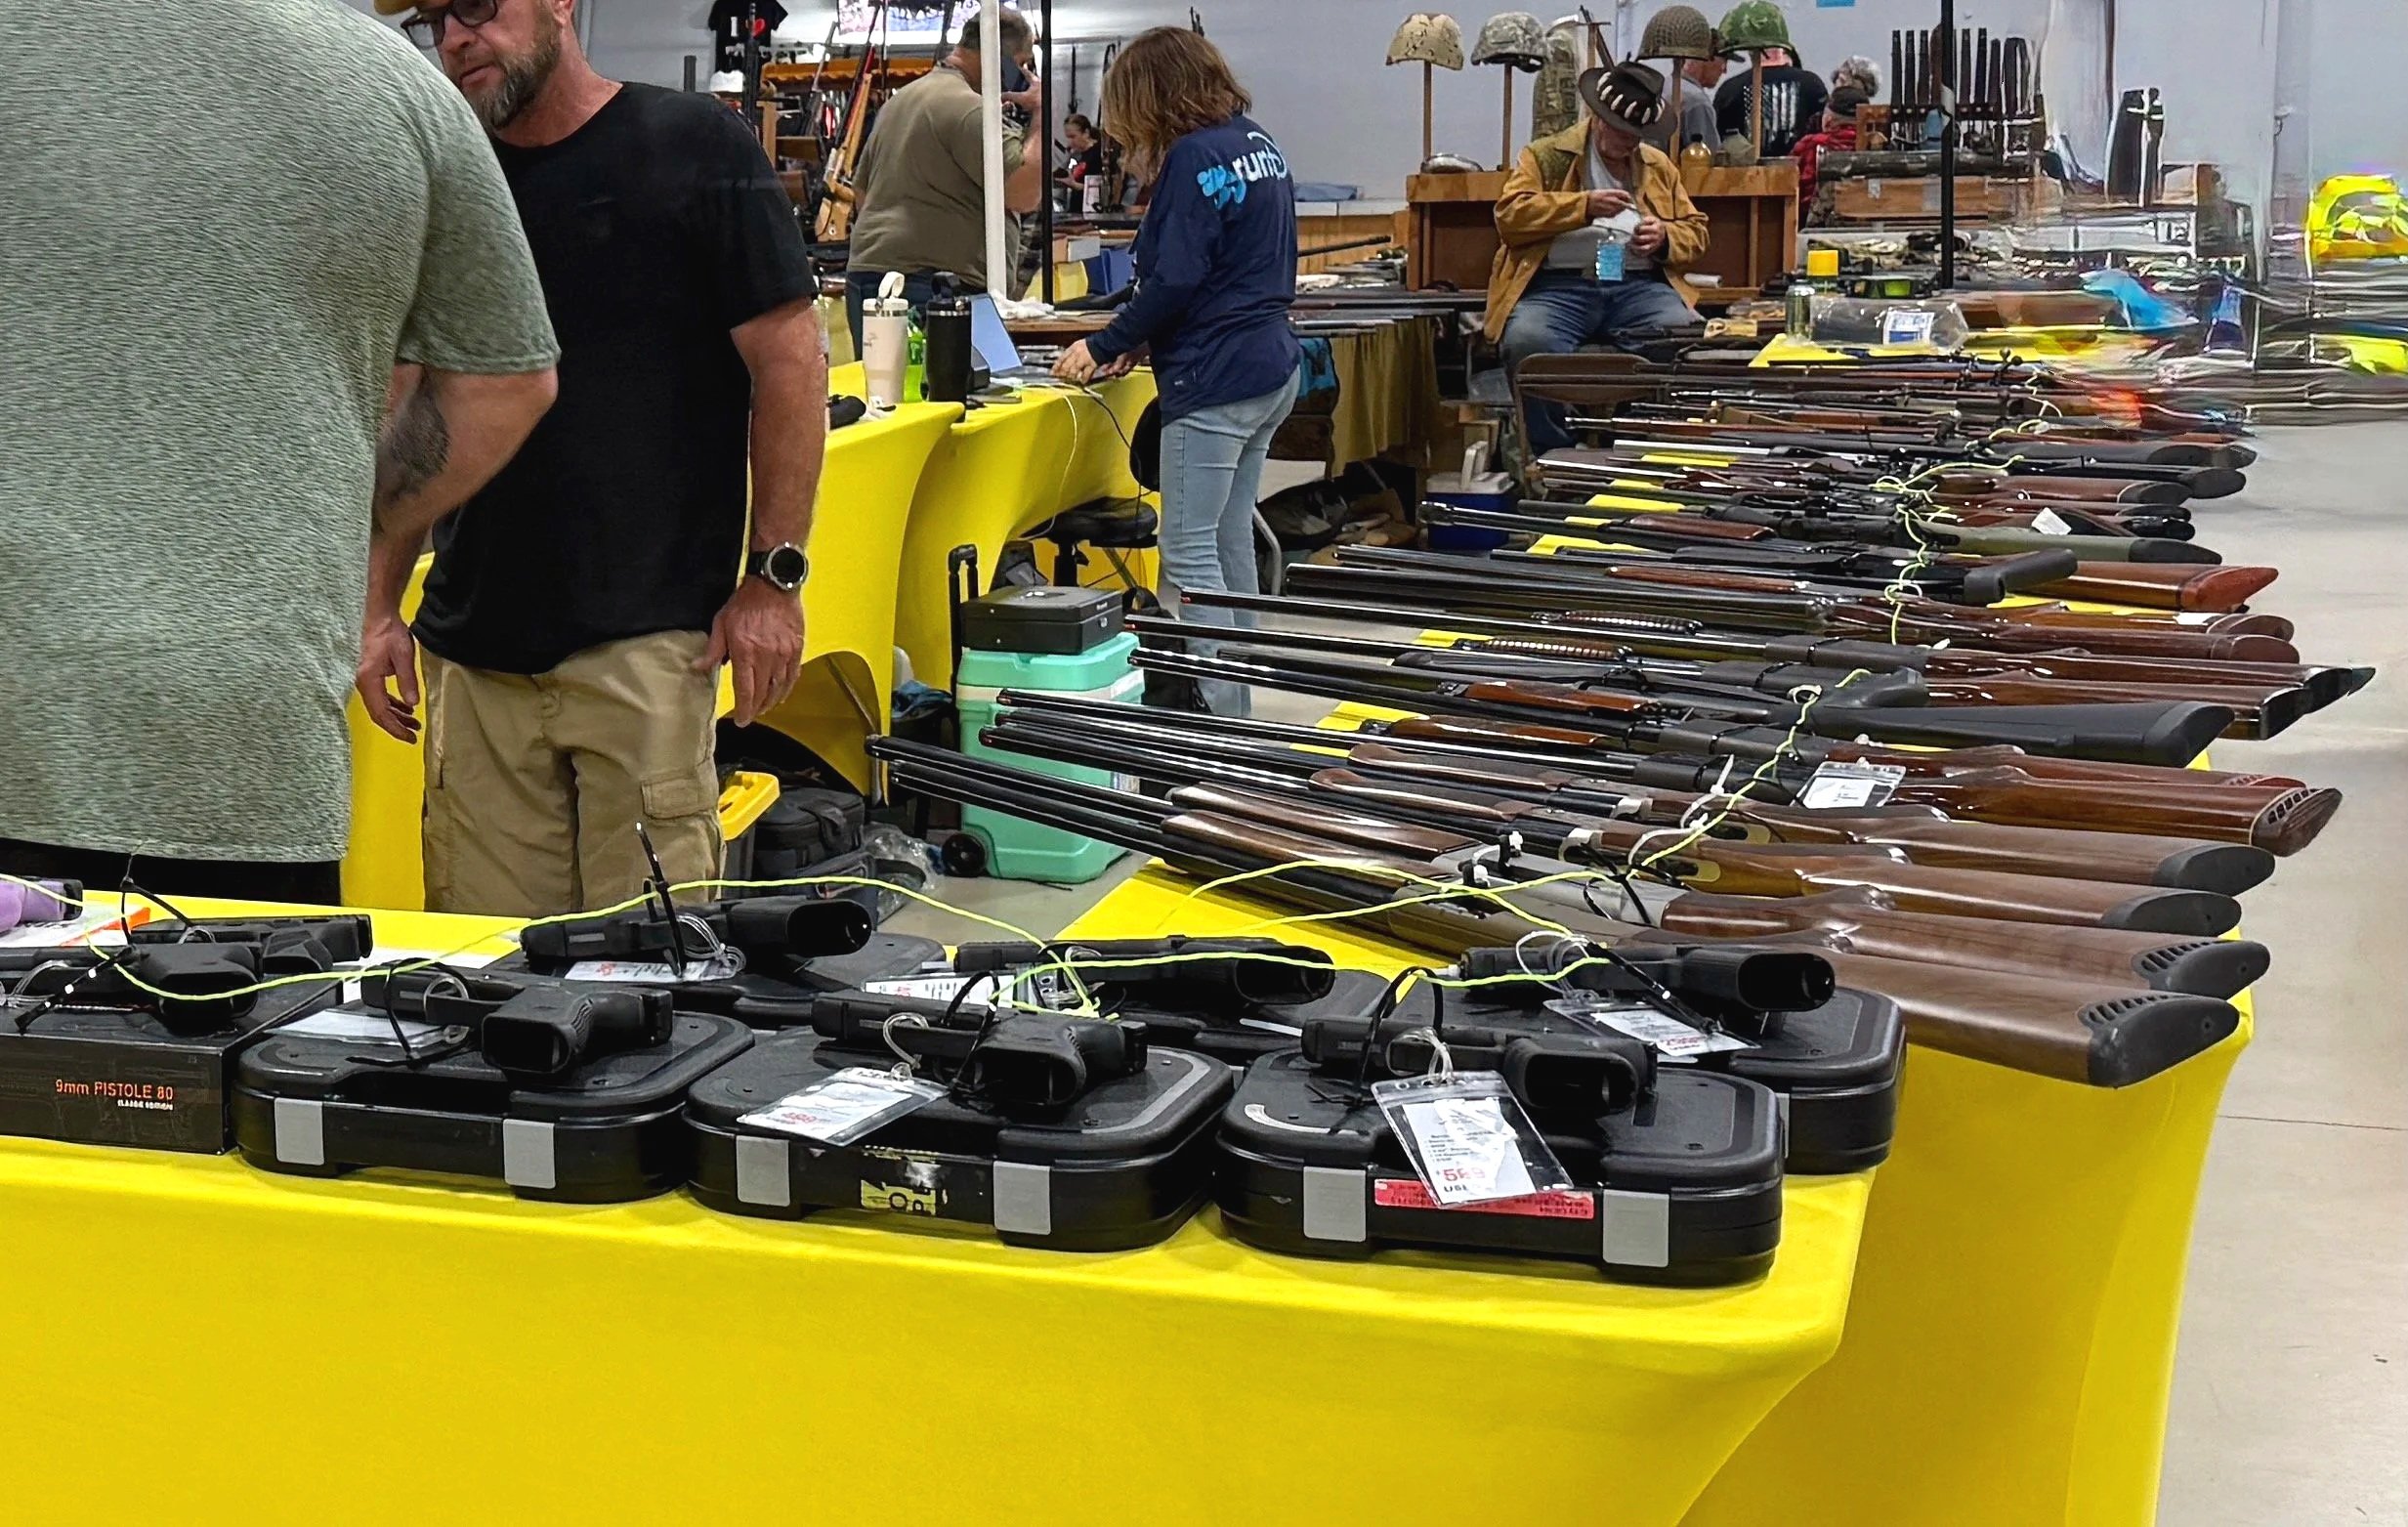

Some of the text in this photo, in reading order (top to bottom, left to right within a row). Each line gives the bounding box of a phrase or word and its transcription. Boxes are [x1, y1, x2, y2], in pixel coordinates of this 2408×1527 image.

[55, 1079, 174, 1100] 9mm PISTOLE 80
